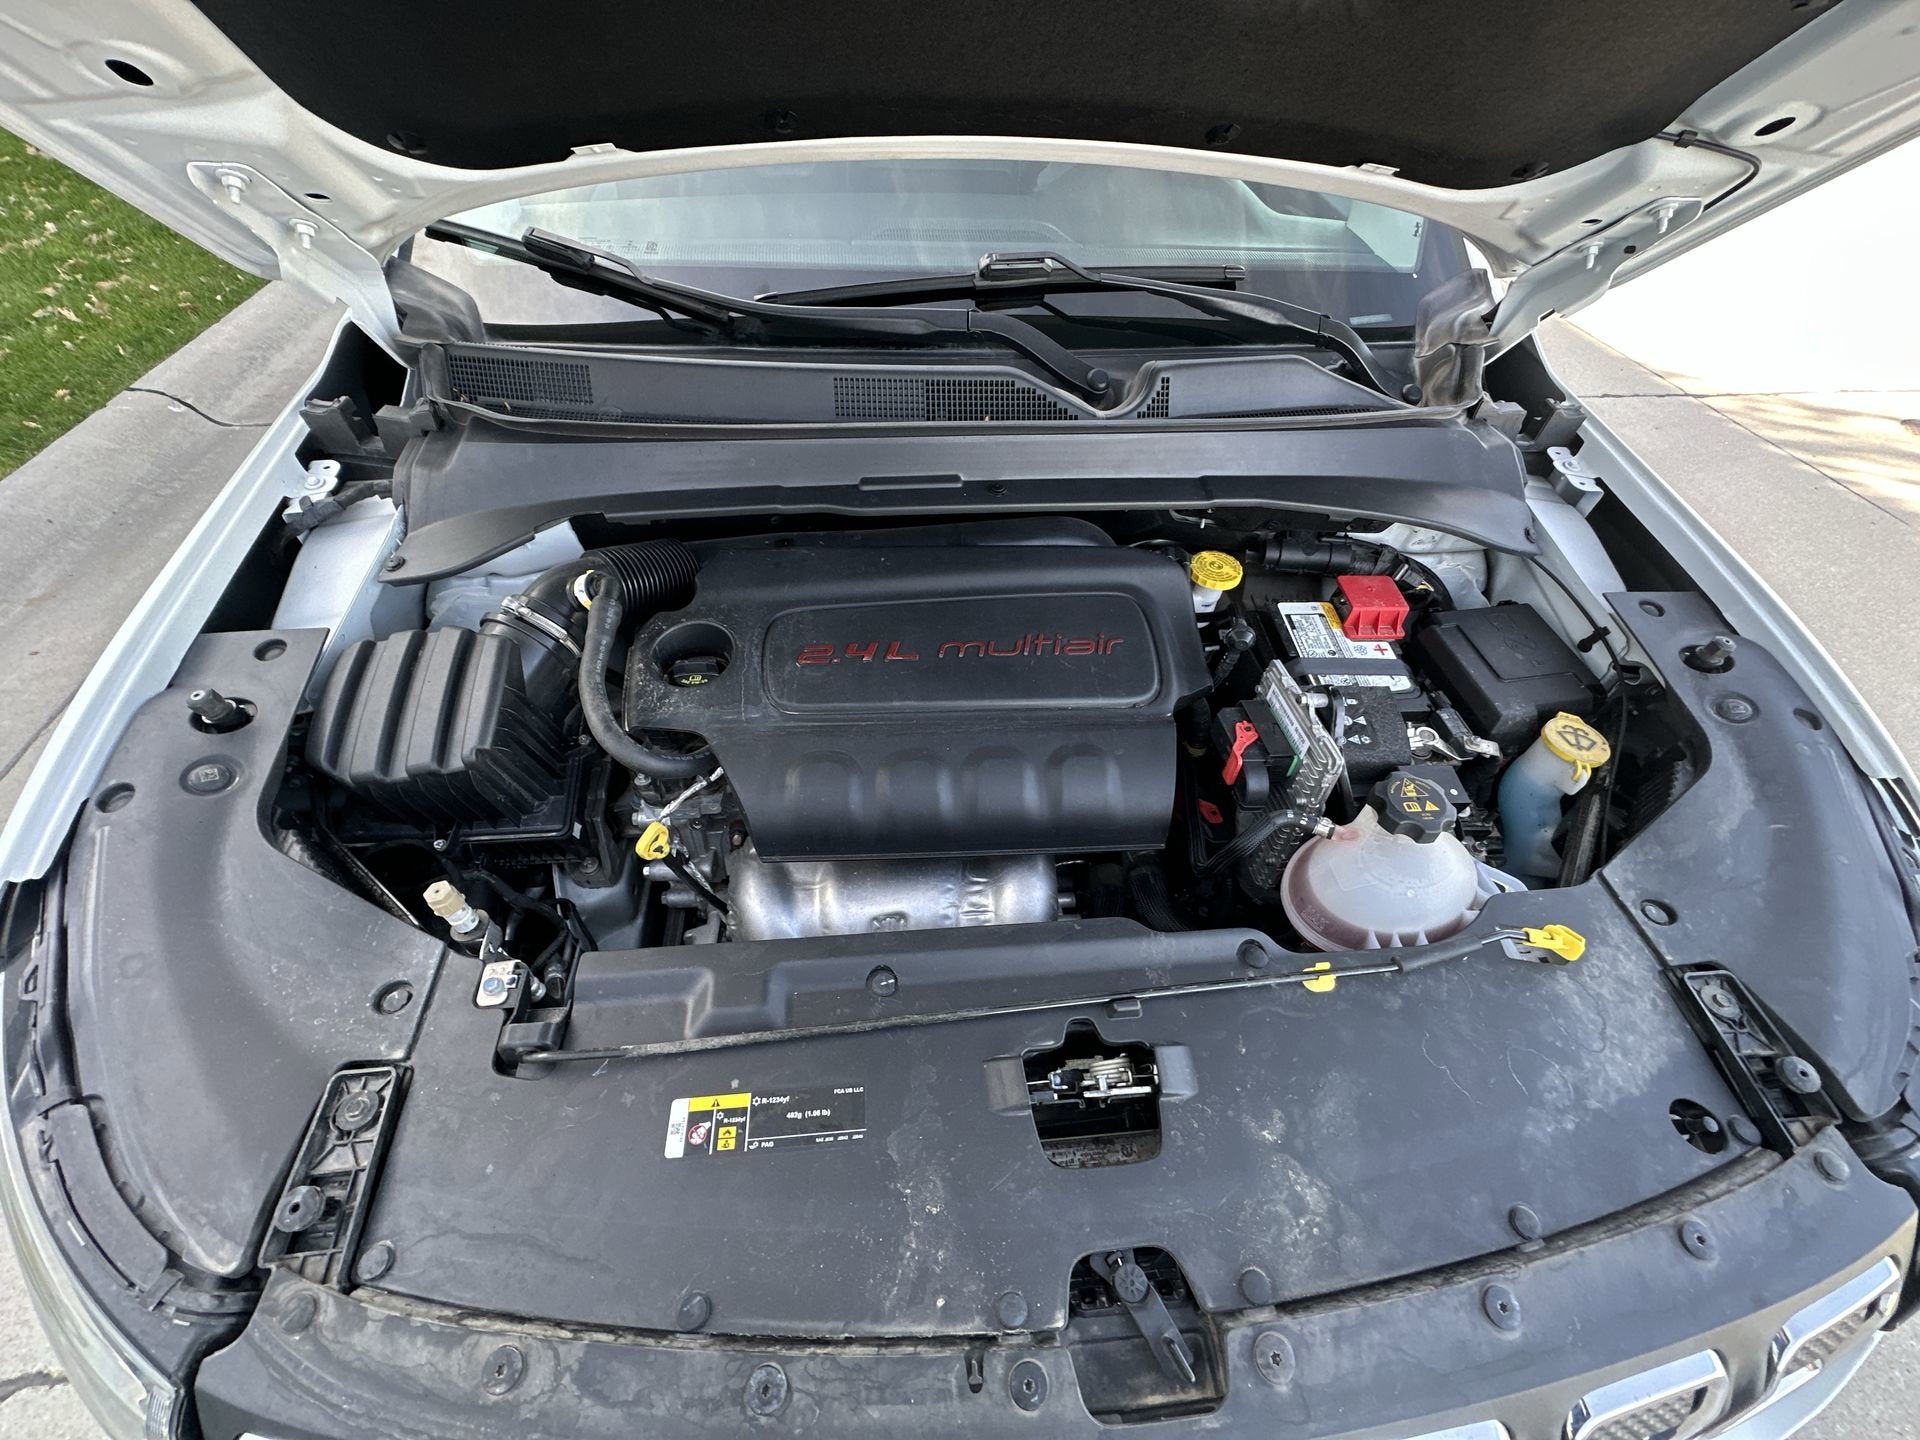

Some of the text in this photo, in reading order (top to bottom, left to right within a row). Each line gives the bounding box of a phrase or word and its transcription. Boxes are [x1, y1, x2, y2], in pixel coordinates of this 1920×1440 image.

[938, 632, 1125, 659] multiair
[833, 1087, 845, 1095] FCA
[761, 1096, 790, 1105] R-1234yf
